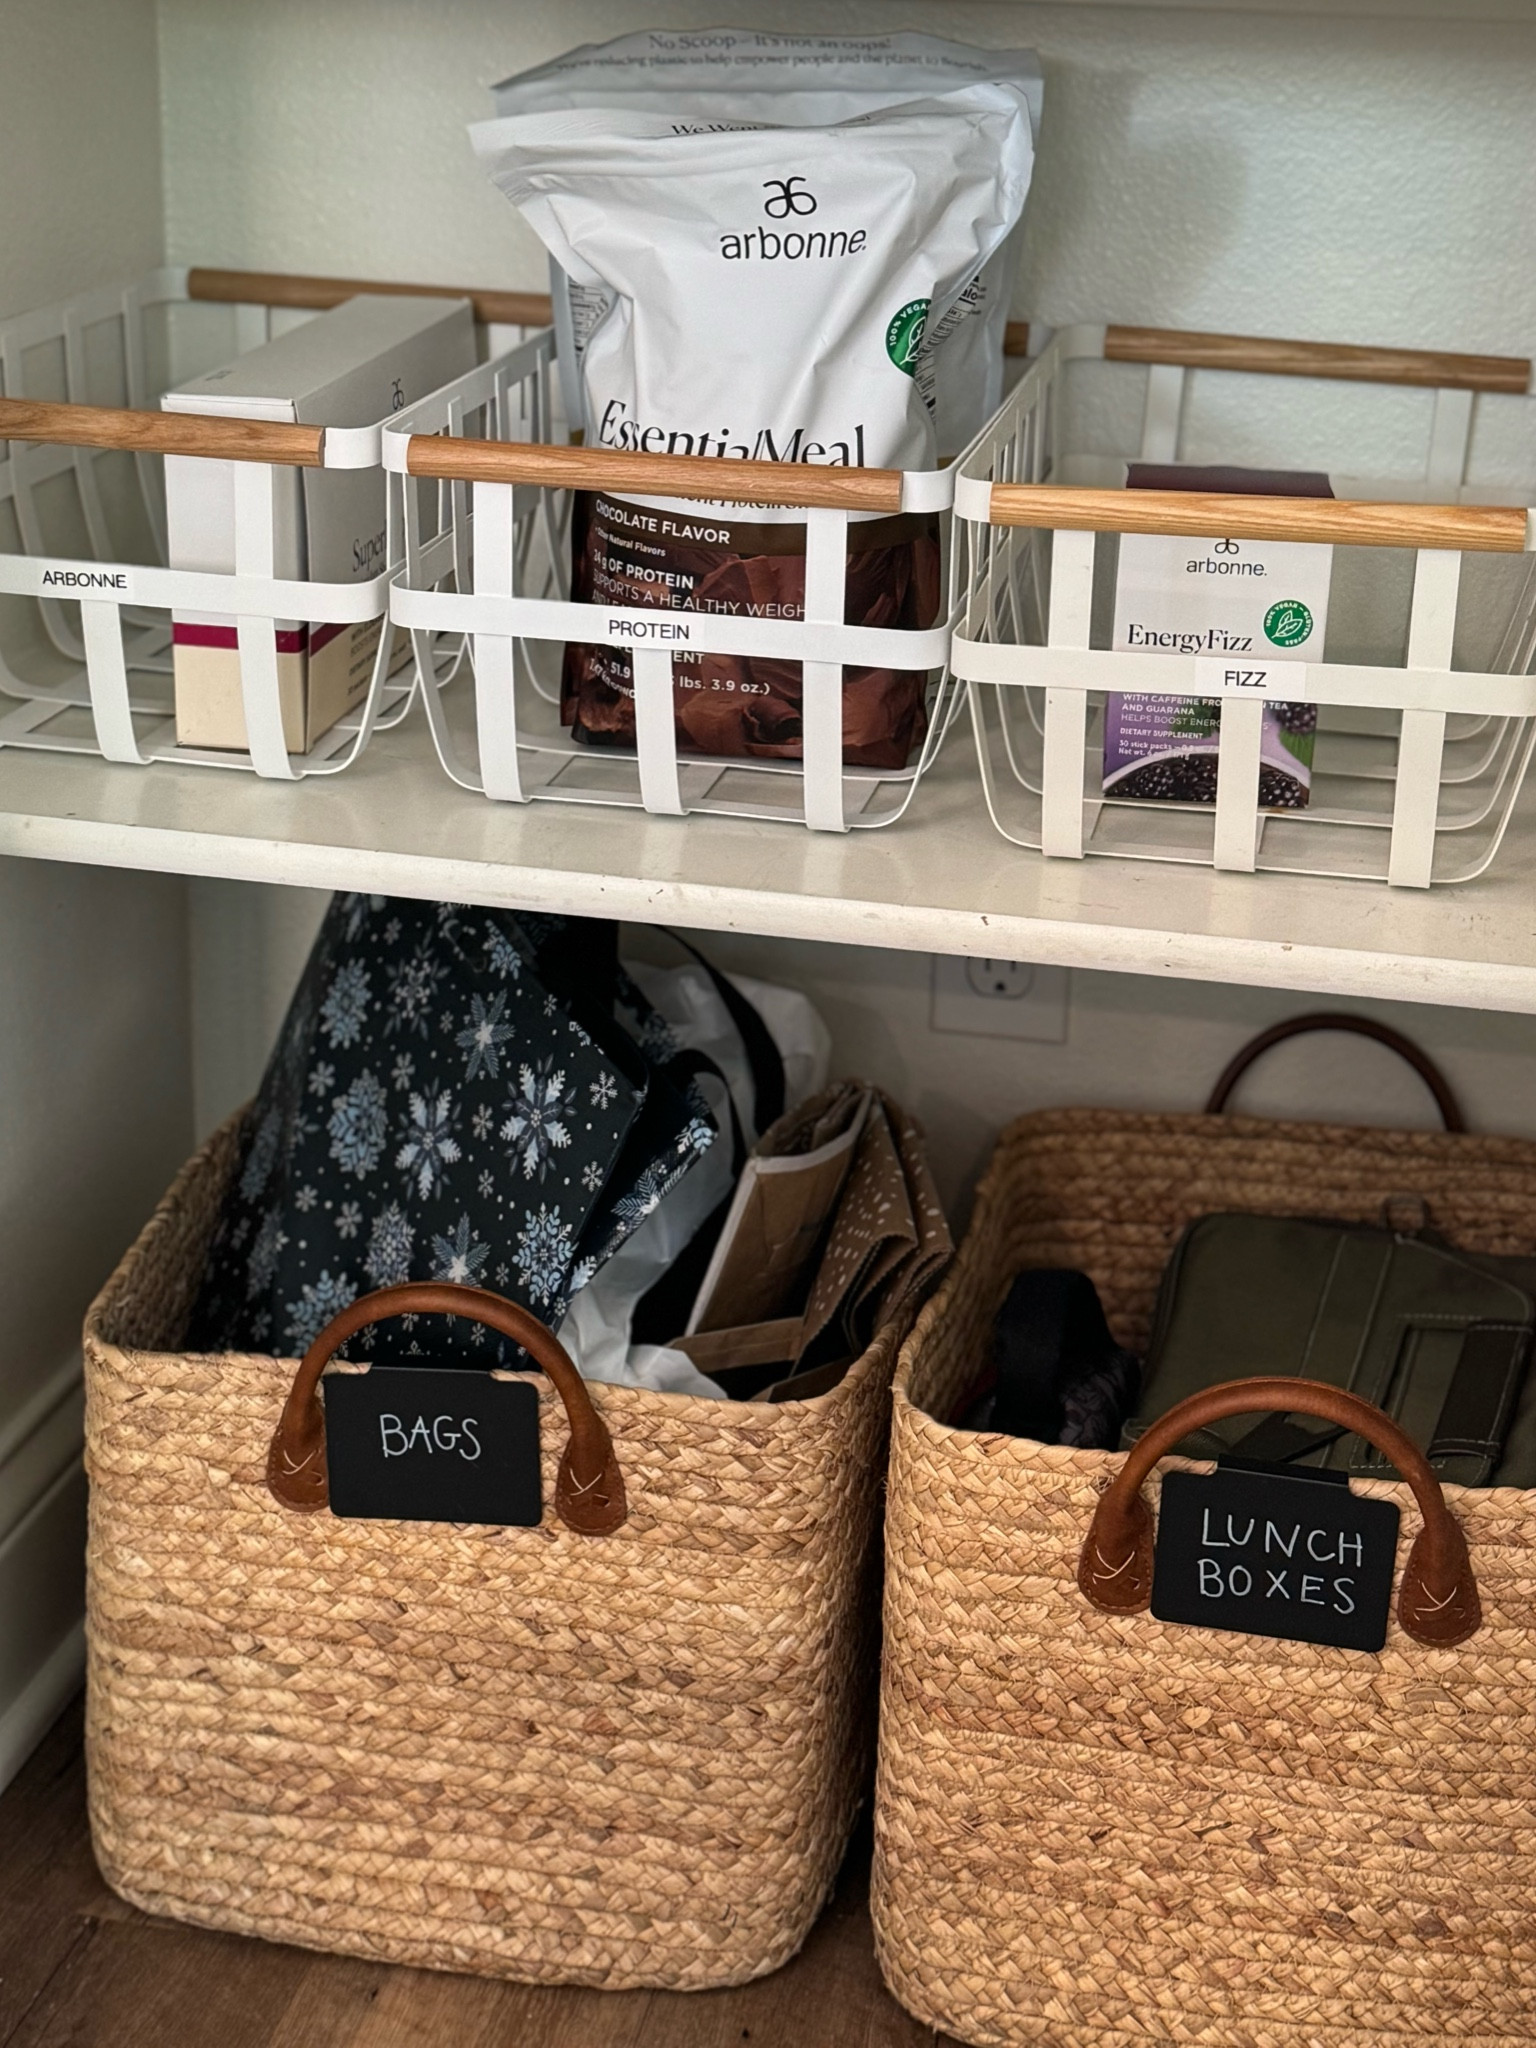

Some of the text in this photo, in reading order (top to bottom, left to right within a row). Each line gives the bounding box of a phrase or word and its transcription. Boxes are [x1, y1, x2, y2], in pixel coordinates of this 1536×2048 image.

[680, 35, 737, 52] Scoop
[900, 302, 931, 319] VEGA
[596, 499, 658, 533] CHOCOLATE
[662, 520, 731, 544] FLAVOR
[635, 541, 666, 557] Flavors
[42, 570, 128, 589] ARBONNE
[608, 557, 624, 574] OF
[626, 563, 694, 590] PROTEIN
[643, 589, 655, 604] A
[659, 591, 741, 616] HEALTHY
[746, 601, 806, 617] WEIGH
[608, 619, 690, 640] PROTEIN
[1127, 623, 1254, 655] EnergyFizz
[610, 661, 631, 679] 51.9
[1224, 670, 1267, 688] FIZZ
[711, 678, 735, 692] 3.9
[1122, 703, 1195, 716] AND GUARANA
[1123, 694, 1289, 710] WITH CAFFEINE FRO TEA
[1121, 713, 1152, 723] HELPS
[1154, 716, 1187, 725] BOOST
[1120, 727, 1203, 739] DIETARY SUPPLEMENT
[379, 1413, 481, 1461] BAGS
[1202, 1508, 1363, 1567] LUNCH
[1197, 1558, 1355, 1614] BOXES
